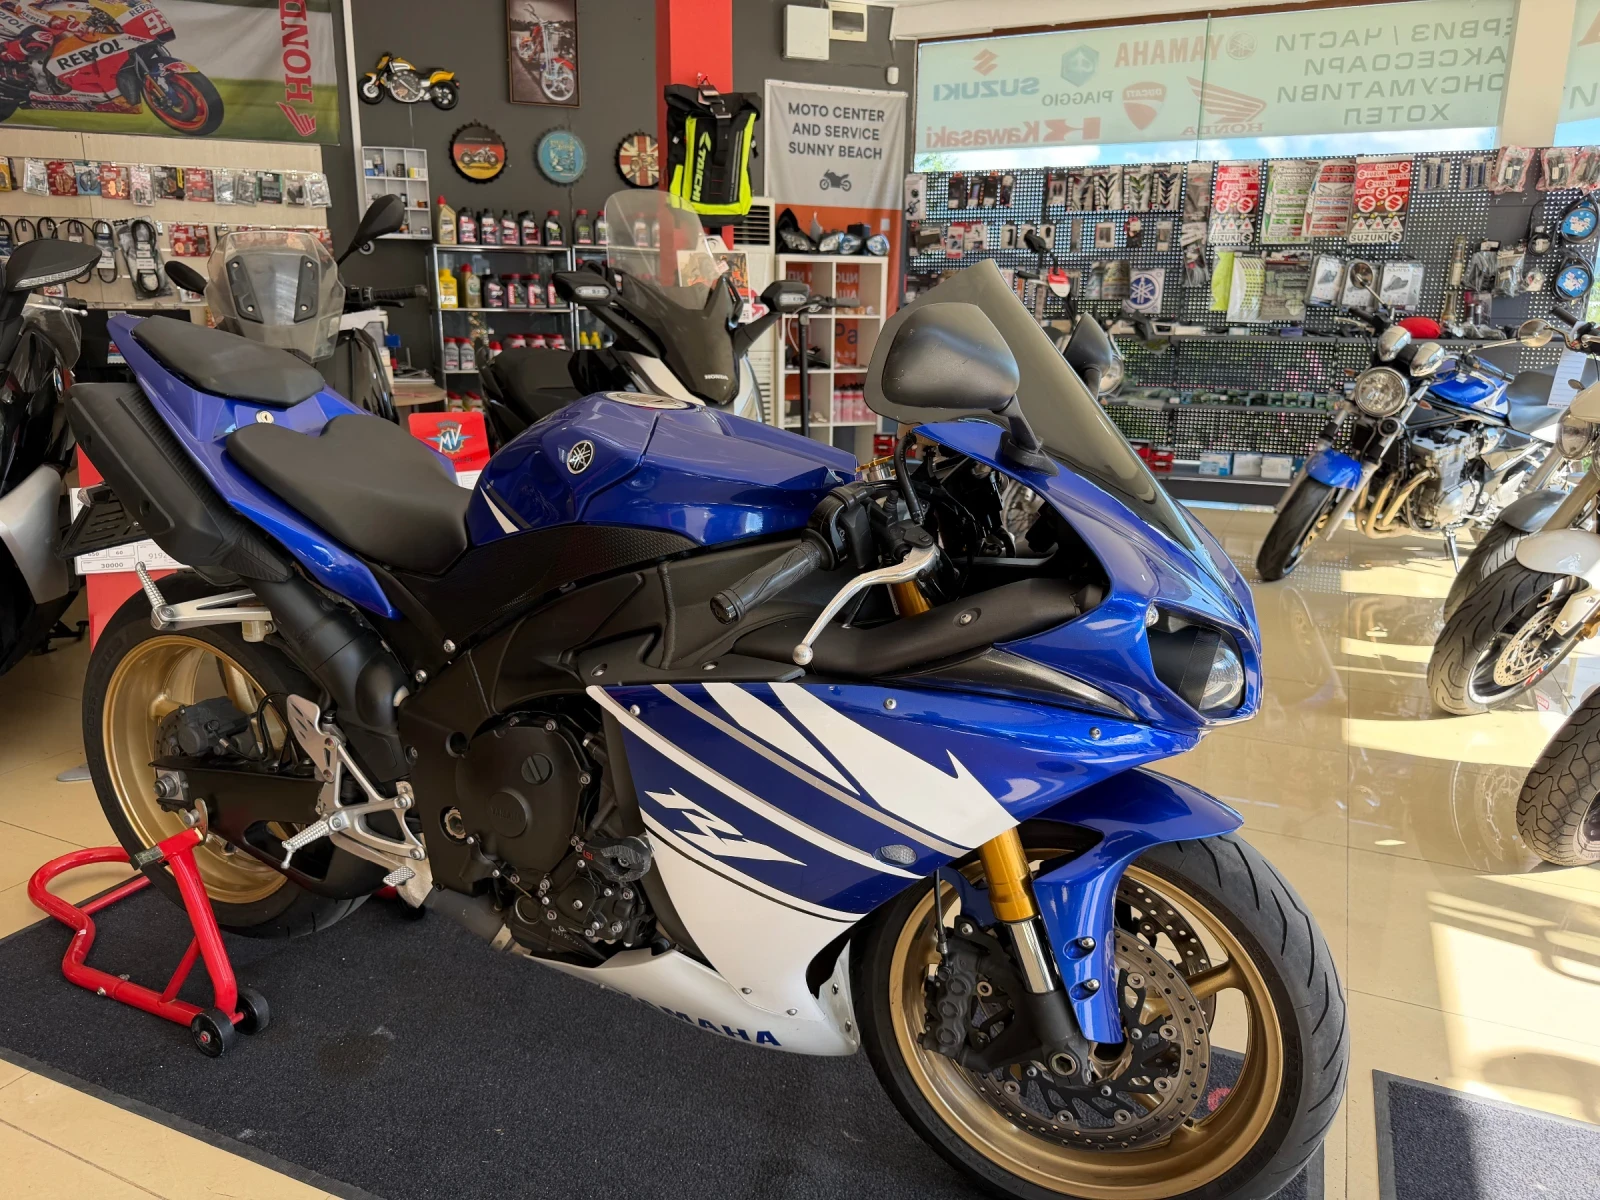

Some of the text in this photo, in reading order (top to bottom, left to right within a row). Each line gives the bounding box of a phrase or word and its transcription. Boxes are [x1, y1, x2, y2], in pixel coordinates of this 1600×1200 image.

[56, 39, 124, 71] REPSOL
[788, 102, 885, 122] MOTO CENTER
[792, 122, 880, 141] AND SERVICE
[788, 141, 882, 160] SUNNY BEACH
[692, 148, 707, 202] TAICHI
[1351, 233, 1387, 242] SUZUKI
[439, 423, 463, 453] MV
